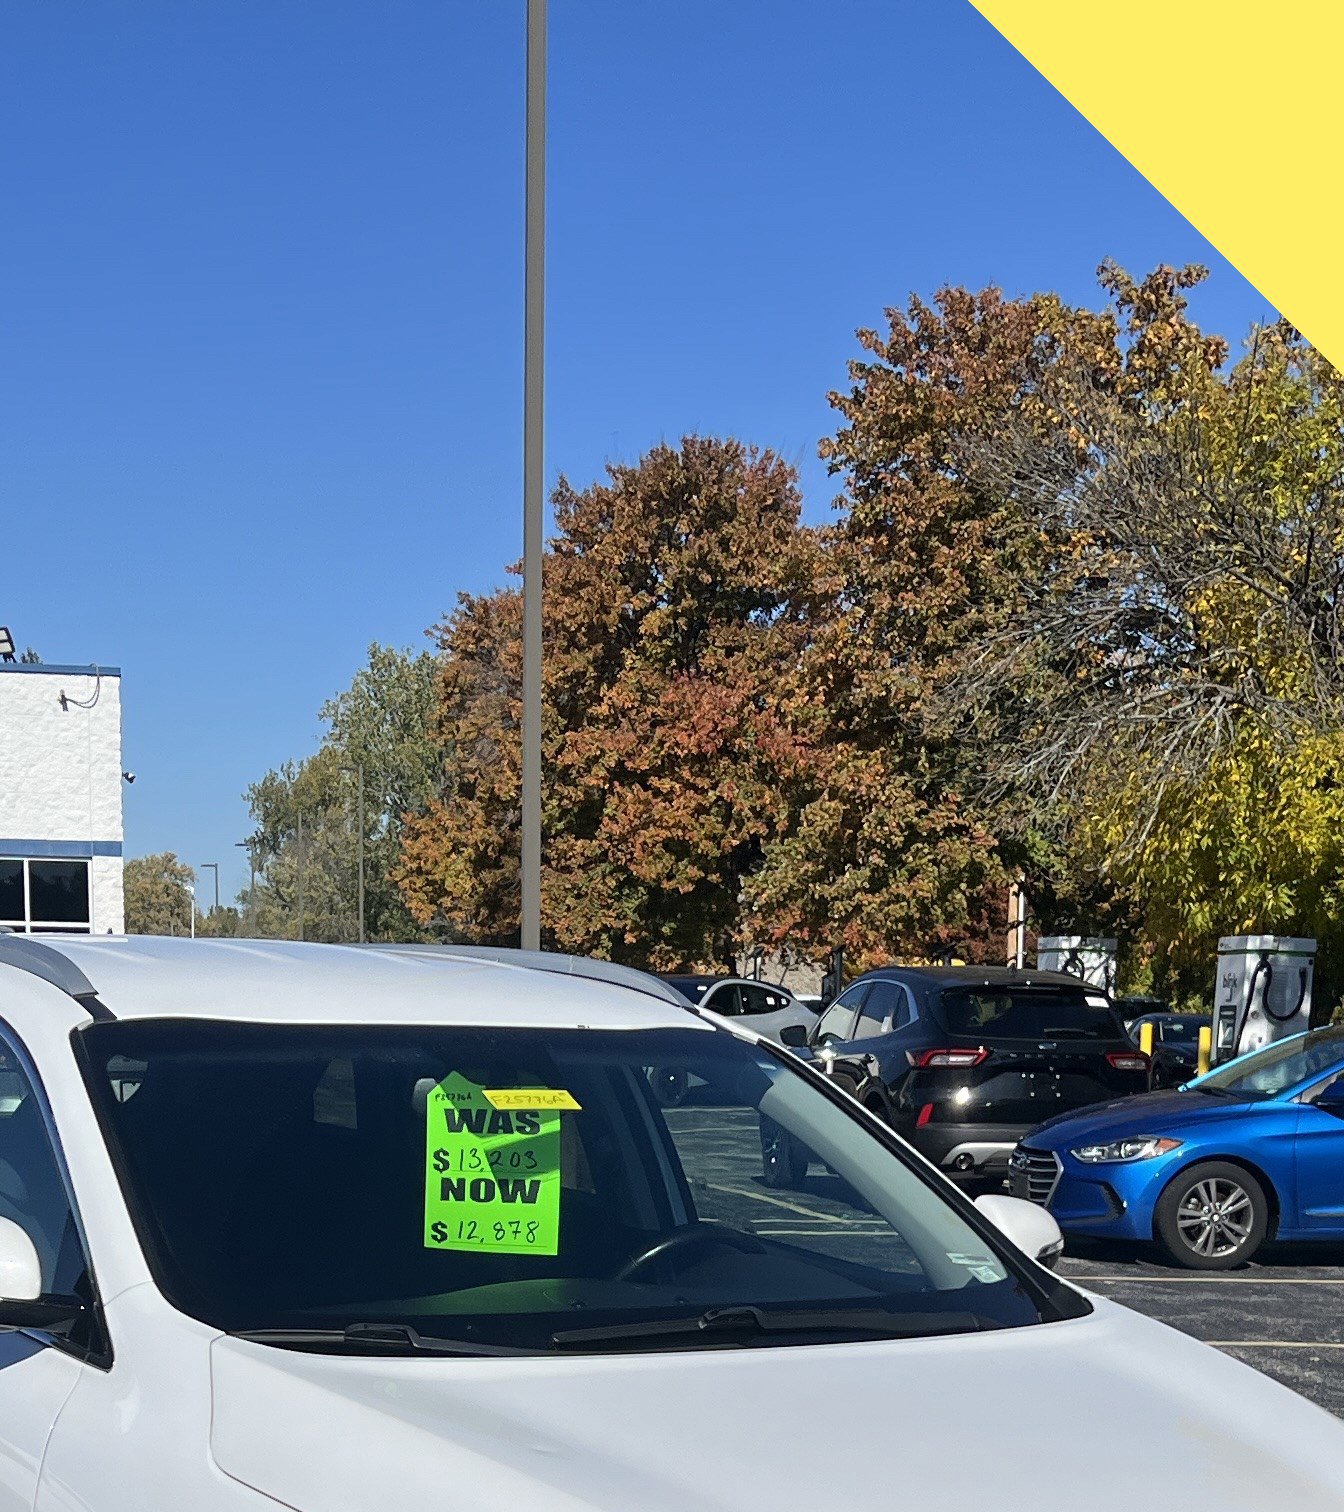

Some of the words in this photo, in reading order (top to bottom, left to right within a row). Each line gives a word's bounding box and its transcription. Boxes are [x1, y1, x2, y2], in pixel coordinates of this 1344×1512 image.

[444, 1108, 540, 1135] WAS
[433, 1148, 450, 1173] $
[440, 1177, 541, 1204] NOW
[431, 1221, 448, 1243] $
